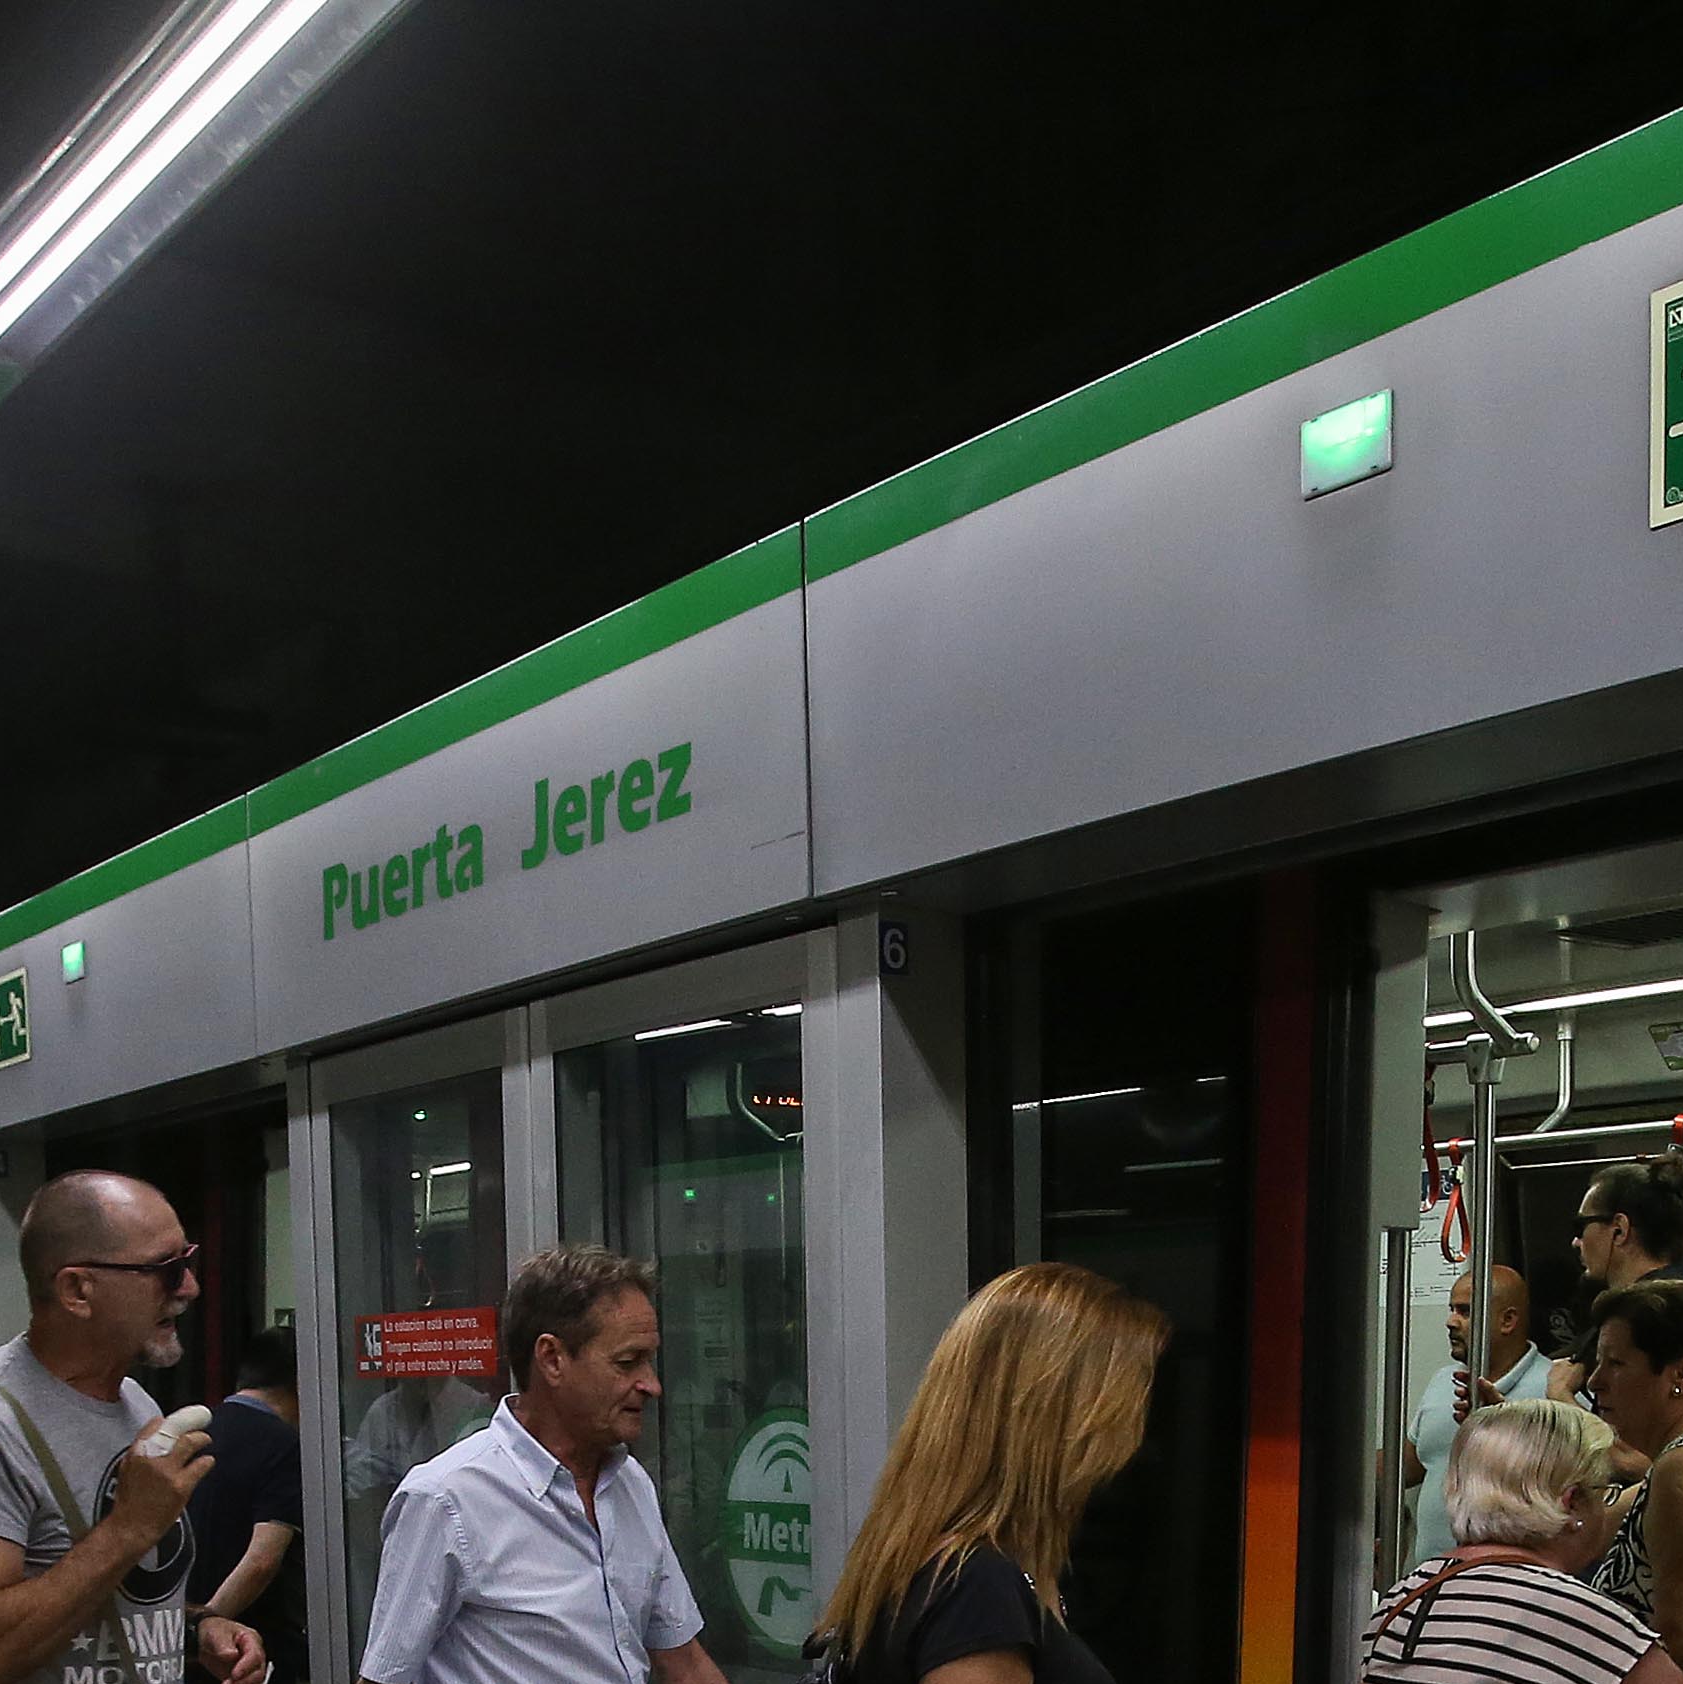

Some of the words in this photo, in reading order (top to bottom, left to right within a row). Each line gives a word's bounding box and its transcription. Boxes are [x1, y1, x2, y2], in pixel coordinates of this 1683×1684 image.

[322, 823, 484, 941] Puerta
[521, 741, 692, 870] Jerez
[883, 928, 906, 969] 6
[384, 1320, 393, 1332] La
[394, 1318, 425, 1331] estación
[427, 1317, 443, 1330] está
[444, 1319, 453, 1329] en
[455, 1318, 479, 1328] curva.
[386, 1340, 411, 1356] Tengan
[412, 1339, 442, 1352] cuidado
[443, 1341, 453, 1350] no
[455, 1336, 492, 1350] introducir
[386, 1360, 393, 1372] el
[394, 1360, 406, 1375] pie
[407, 1360, 425, 1371] entre
[427, 1358, 450, 1370] coche
[452, 1360, 457, 1374] y
[97, 1609, 184, 1662] BMW
